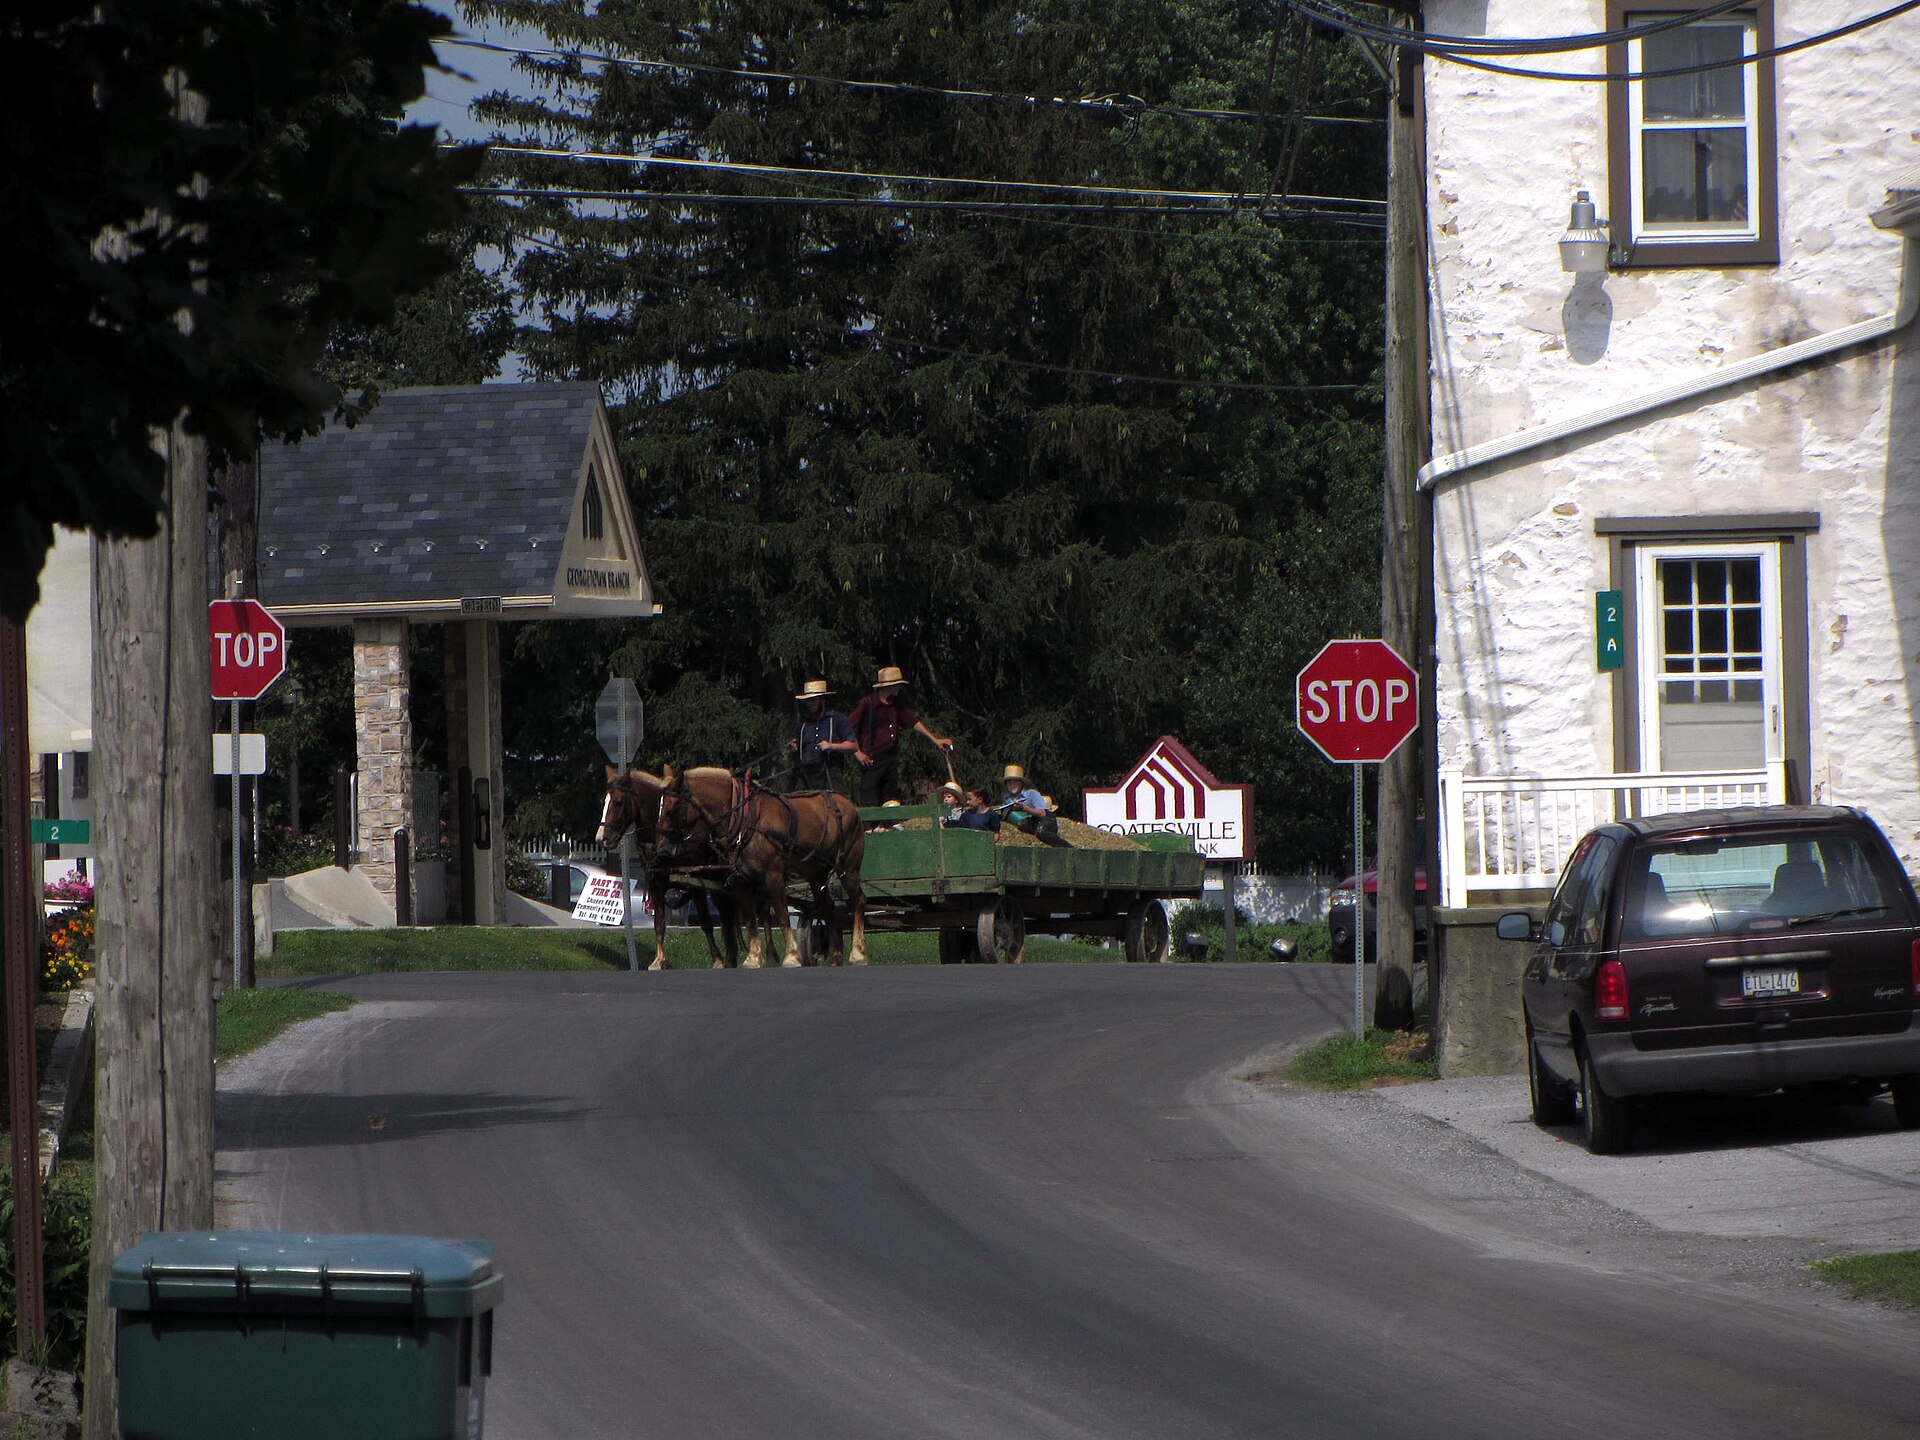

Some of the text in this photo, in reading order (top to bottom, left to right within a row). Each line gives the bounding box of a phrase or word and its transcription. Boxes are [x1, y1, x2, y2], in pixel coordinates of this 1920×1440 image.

[1607, 607, 1616, 622] 2
[214, 632, 277, 668] TOP
[1607, 638, 1617, 652] A
[1306, 678, 1409, 724] STOP
[51, 826, 59, 840] 2
[1198, 843, 1218, 855] NK
[590, 878, 612, 887] BART
[592, 888, 610, 897] FIRE
